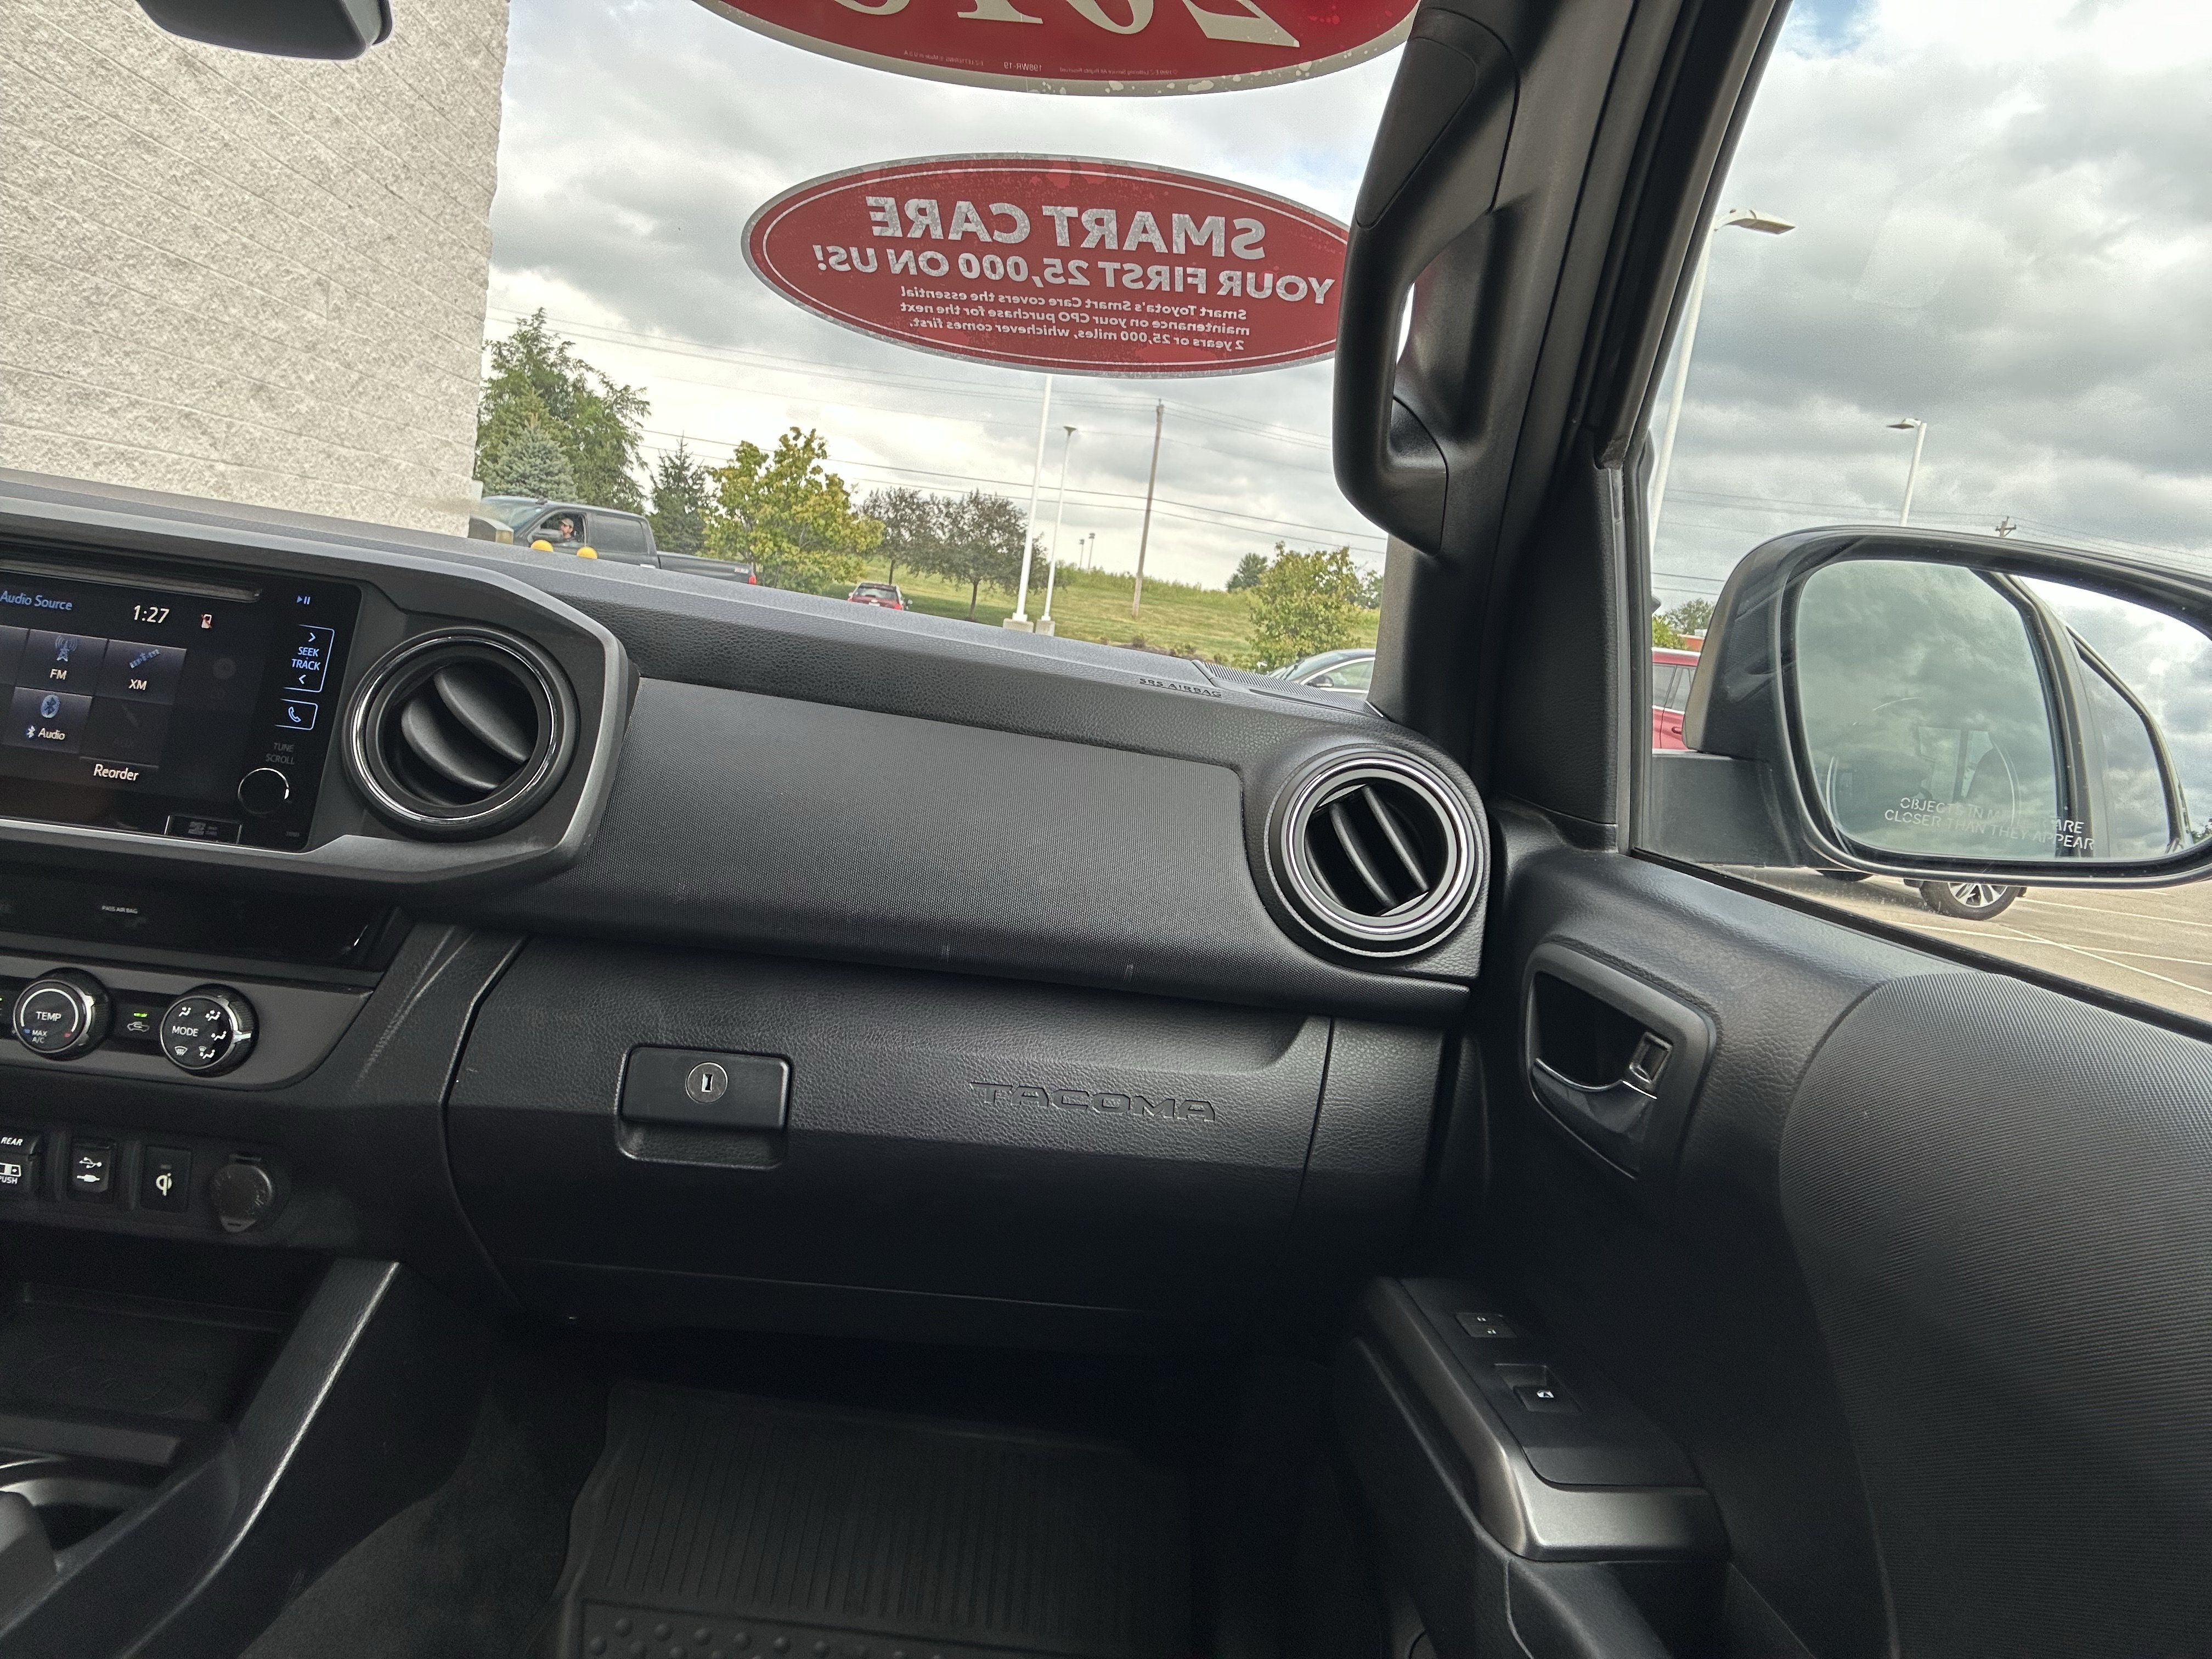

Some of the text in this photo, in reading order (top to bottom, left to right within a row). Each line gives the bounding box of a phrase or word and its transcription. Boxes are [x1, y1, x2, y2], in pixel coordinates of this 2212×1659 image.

[0, 590, 73, 611] Audio Source
[133, 605, 170, 624] 1:27
[297, 646, 320, 657] SEEK
[291, 658, 321, 671] TRACK
[49, 669, 67, 680] FM
[128, 679, 148, 691] XM
[1139, 678, 1164, 687] SRS
[38, 727, 66, 741] Audio
[274, 742, 295, 753] TUNE
[266, 753, 295, 765] SCROLL
[93, 763, 139, 781] Reorder
[1900, 797, 1963, 816] OBJECTS
[1968, 803, 1984, 819] IN
[2052, 818, 2085, 834] ARE
[1884, 809, 1942, 827] CLOSER
[1947, 817, 1985, 834] THAN
[1988, 823, 2030, 840] THEY
[2032, 831, 2095, 850] APPEAR
[36, 1011, 63, 1022] TEMP
[31, 1029, 48, 1037] MAX
[171, 1025, 199, 1037] MODE
[969, 1081, 1216, 1122] TACOMA
[1, 1137, 23, 1146] REAR
